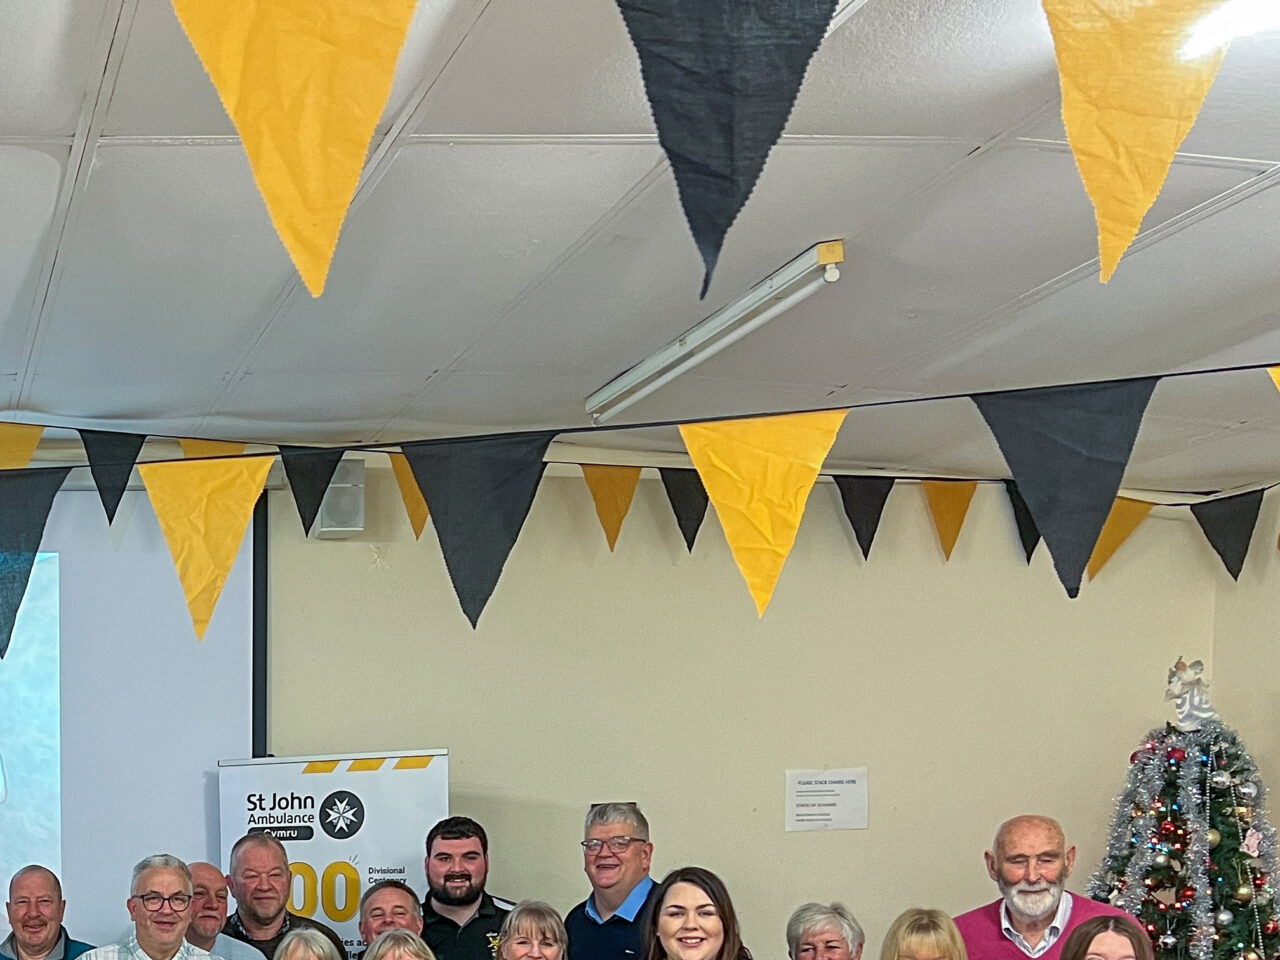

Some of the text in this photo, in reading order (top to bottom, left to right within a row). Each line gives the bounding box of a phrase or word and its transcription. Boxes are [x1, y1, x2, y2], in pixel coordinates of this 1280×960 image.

[247, 791, 315, 811] St John
[247, 812, 315, 826] Ambulance
[368, 866, 406, 875] Divisional
[287, 861, 361, 923] 00
